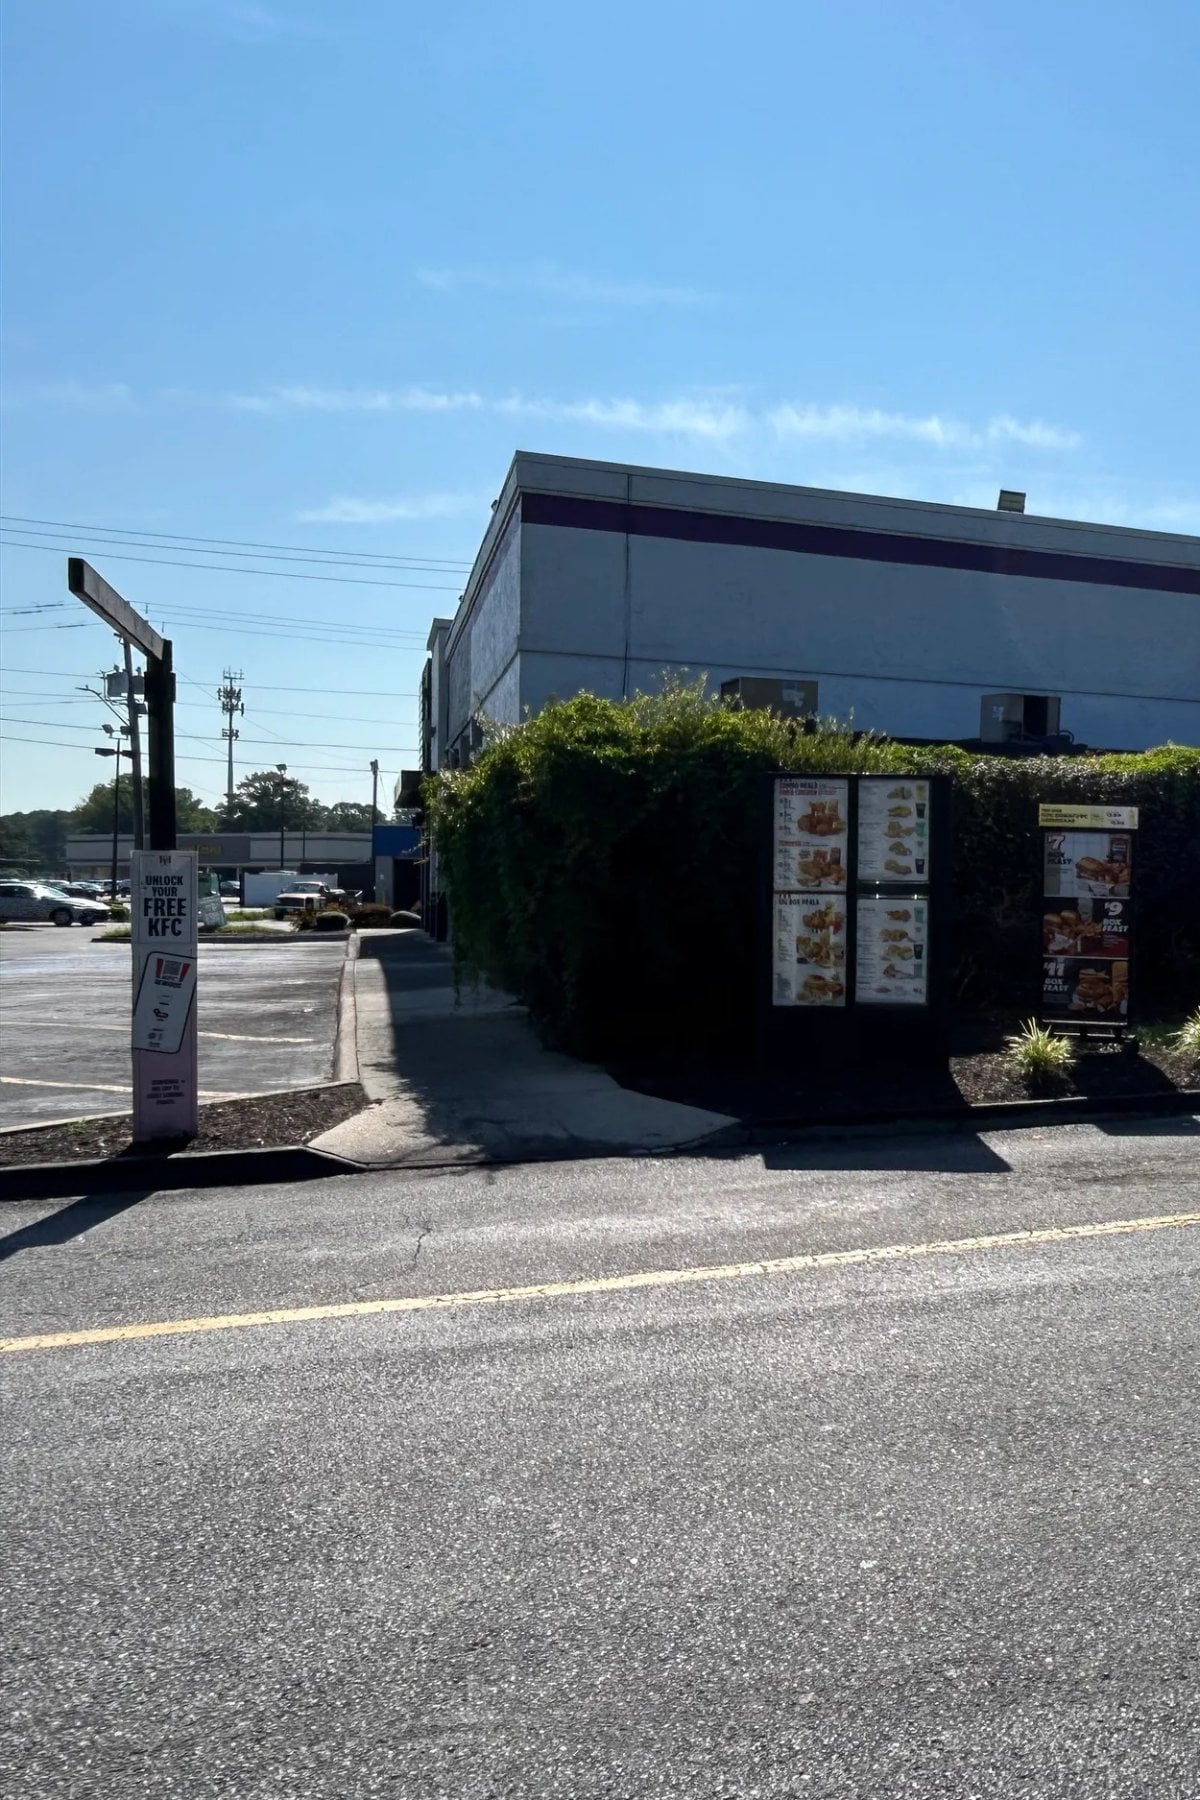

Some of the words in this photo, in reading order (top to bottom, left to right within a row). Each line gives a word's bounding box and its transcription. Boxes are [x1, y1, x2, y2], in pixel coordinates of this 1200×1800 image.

[145, 875, 184, 886] UNLOCK
[151, 886, 178, 897] YOUR
[143, 897, 187, 917] FREE
[148, 917, 182, 937] KFC
[1044, 977, 1064, 985] BOX
[1042, 984, 1070, 992] FEAST
